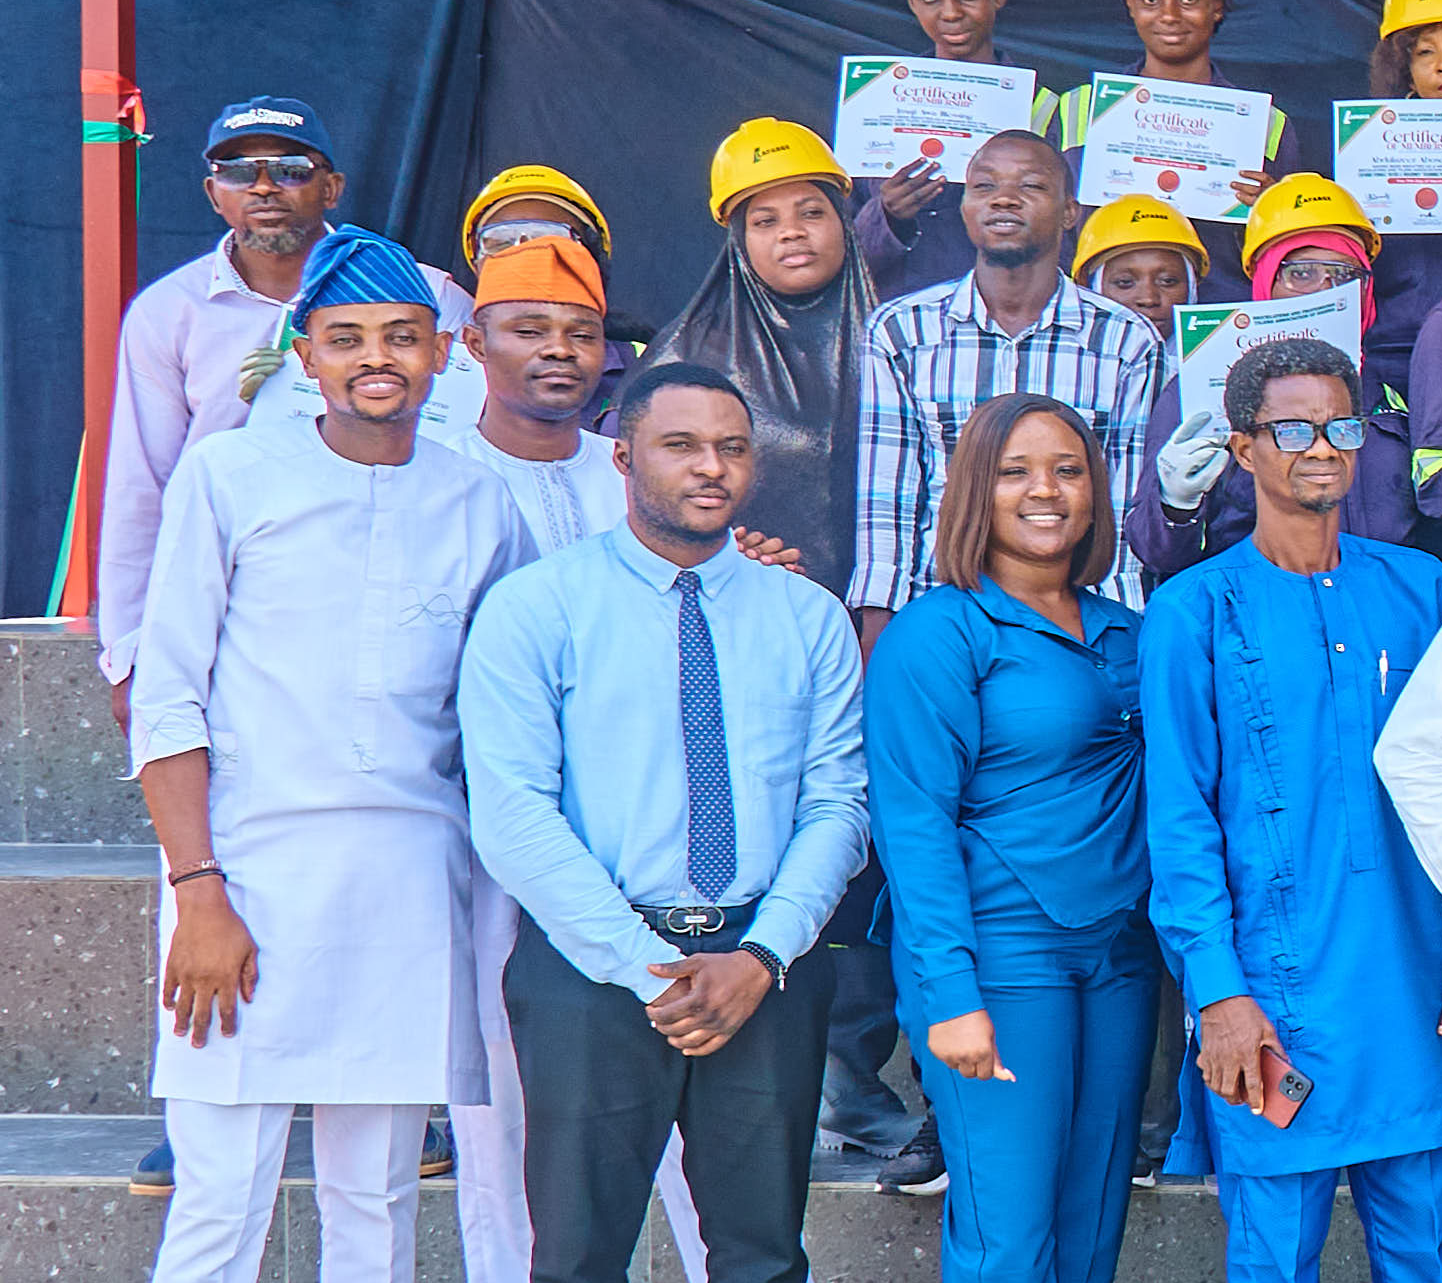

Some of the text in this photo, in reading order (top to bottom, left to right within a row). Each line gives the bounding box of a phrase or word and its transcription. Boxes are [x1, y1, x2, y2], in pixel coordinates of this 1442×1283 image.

[892, 84, 977, 101] Certificate
[1134, 109, 1214, 129] Certificate
[1293, 194, 1332, 209] LAFARGE
[1130, 209, 1169, 223] LAFARGE
